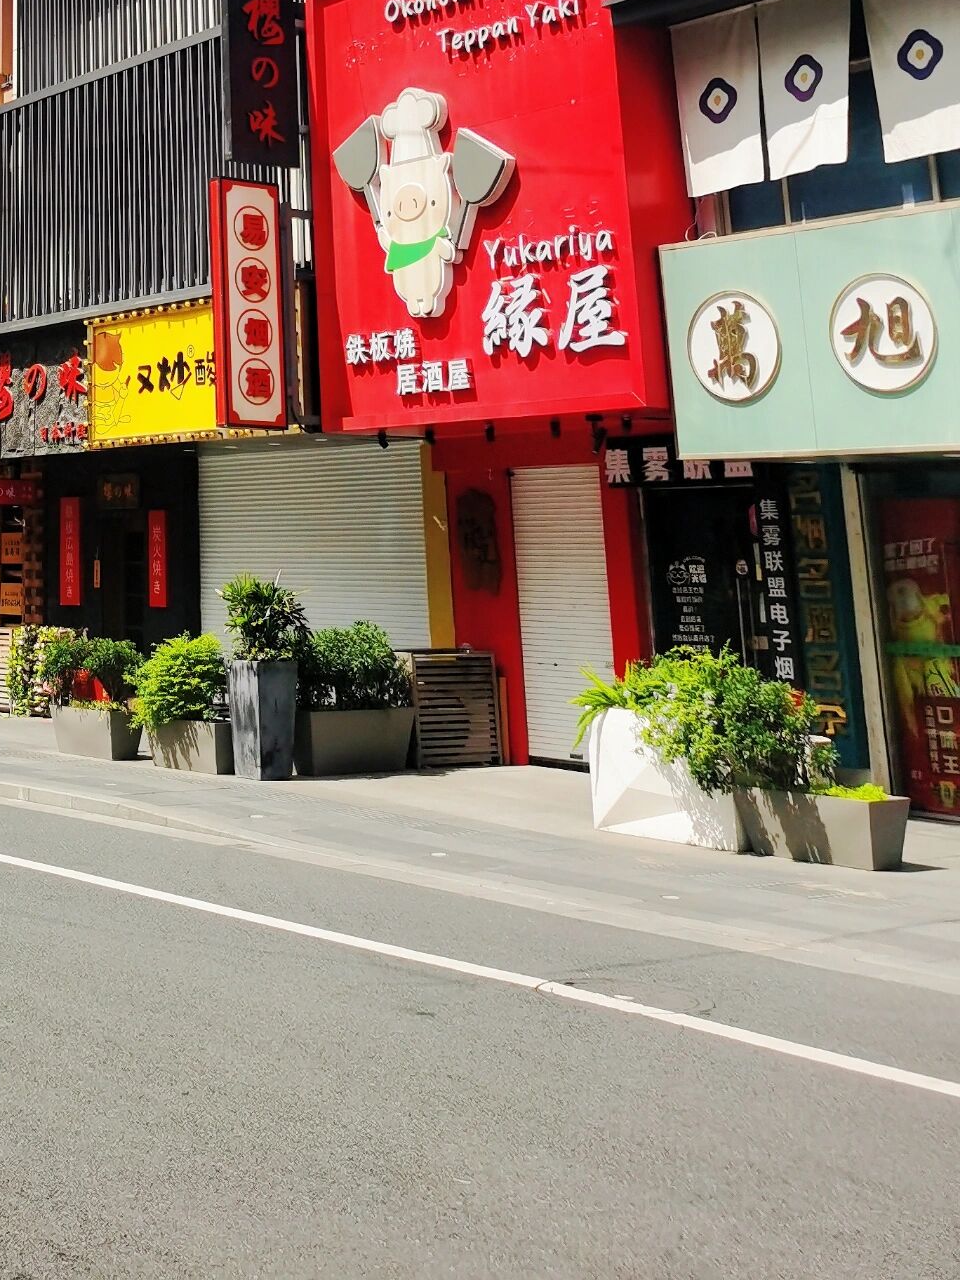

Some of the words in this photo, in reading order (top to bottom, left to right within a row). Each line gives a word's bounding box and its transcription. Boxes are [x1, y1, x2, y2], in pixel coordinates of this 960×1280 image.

[436, 16, 518, 53] Teppan
[483, 225, 612, 269] Yukariya
[397, 359, 471, 395] 居酒屋
[759, 498, 795, 681] 集雾联盟电子烟
